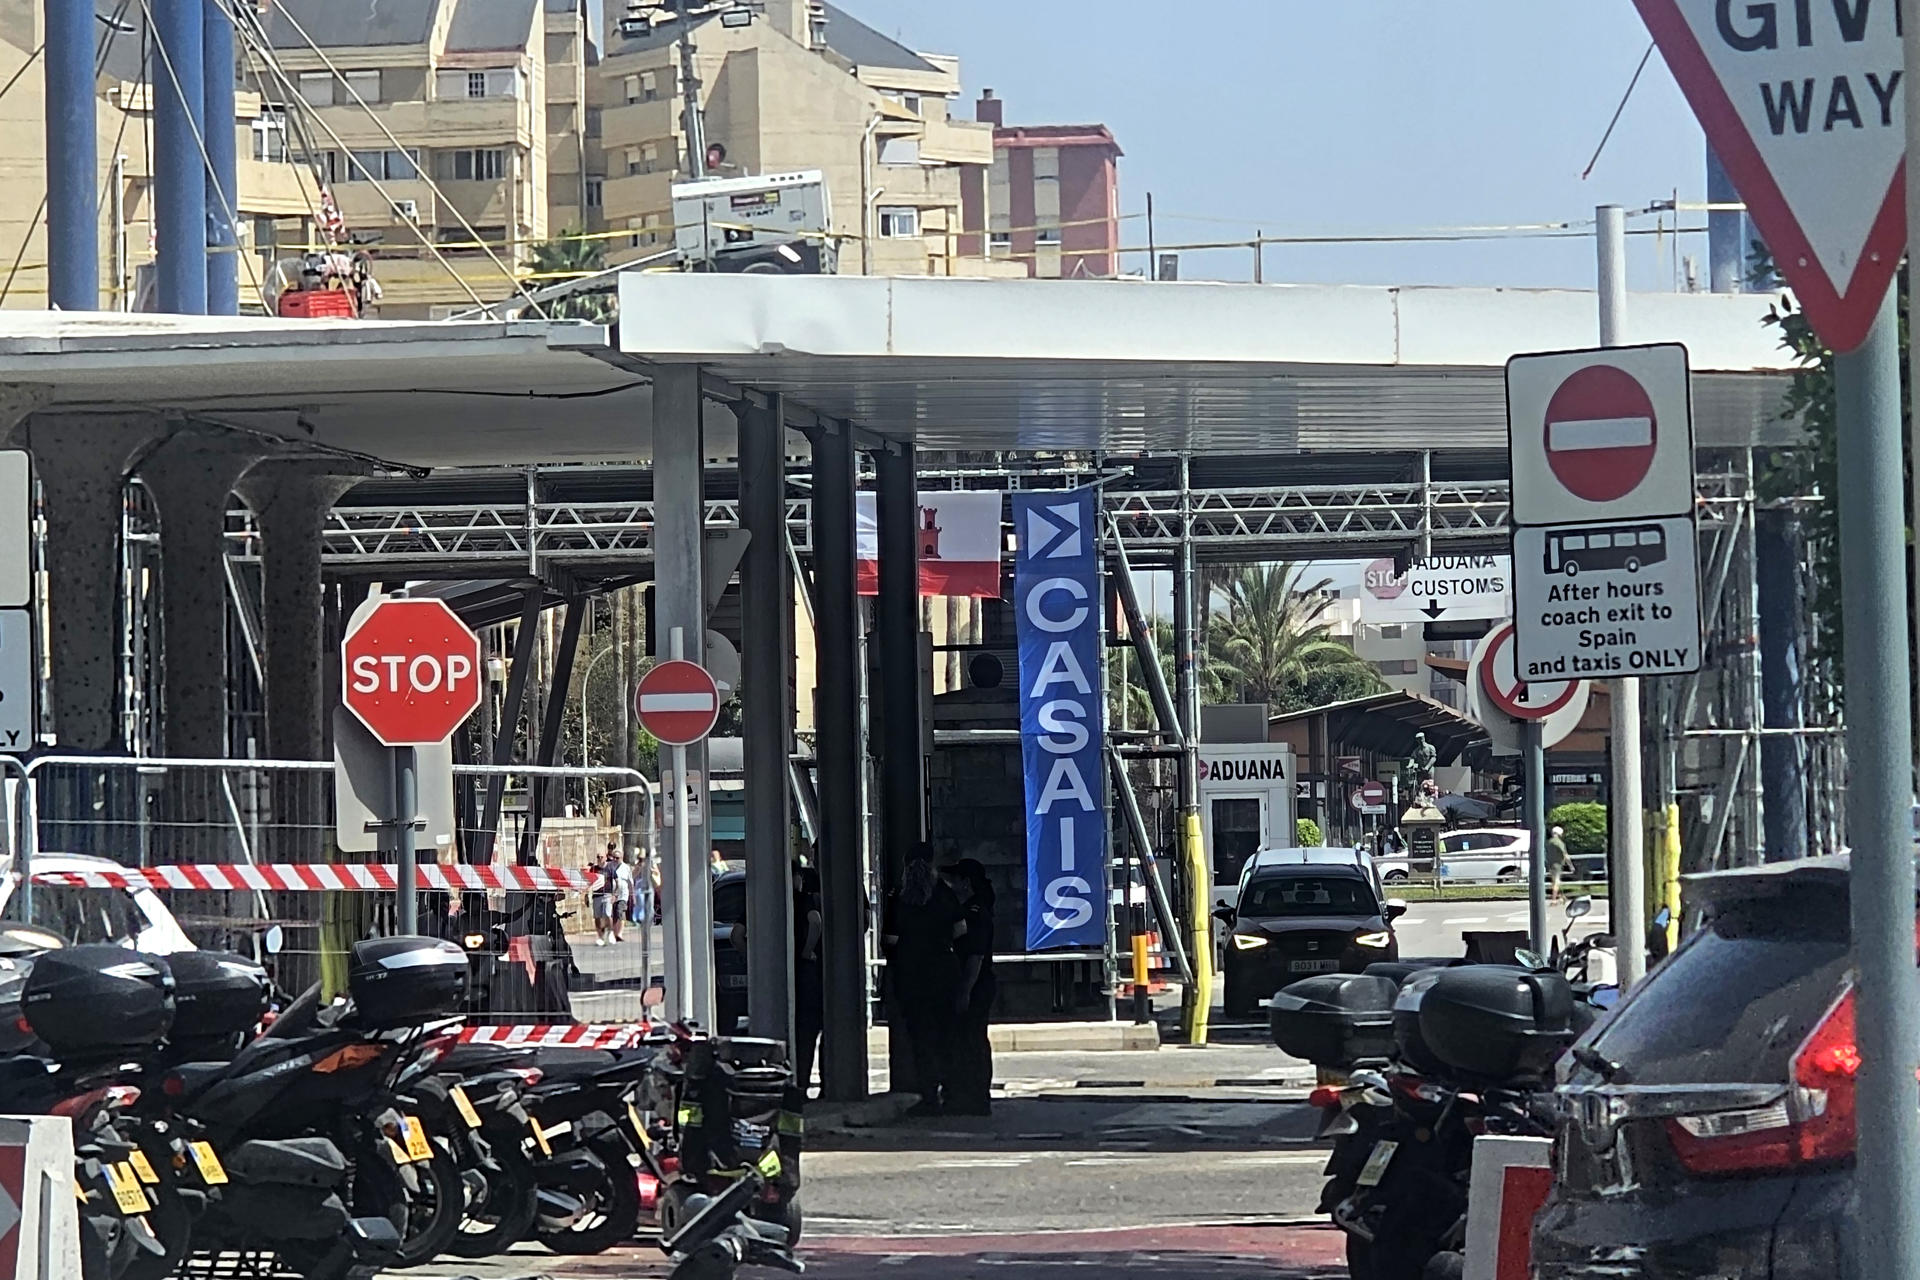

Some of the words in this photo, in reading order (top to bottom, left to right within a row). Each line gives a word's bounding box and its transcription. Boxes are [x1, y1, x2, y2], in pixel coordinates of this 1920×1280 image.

[1715, 0, 1904, 51] GIV
[1759, 70, 1905, 135] WAY
[1411, 577, 1504, 596] CUSTOMS
[1548, 584, 1600, 602] After
[1607, 581, 1664, 598] hours
[1541, 606, 1600, 626] coach
[1607, 603, 1645, 621] exit
[1651, 602, 1672, 620] to
[1578, 628, 1636, 649] Spain
[352, 654, 471, 693] STOP
[1528, 656, 1566, 675] and
[1572, 652, 1621, 672] taxis
[1629, 648, 1688, 669] ONLY
[1025, 577, 1096, 930] CASAIS
[1210, 760, 1285, 781] ADUANA
